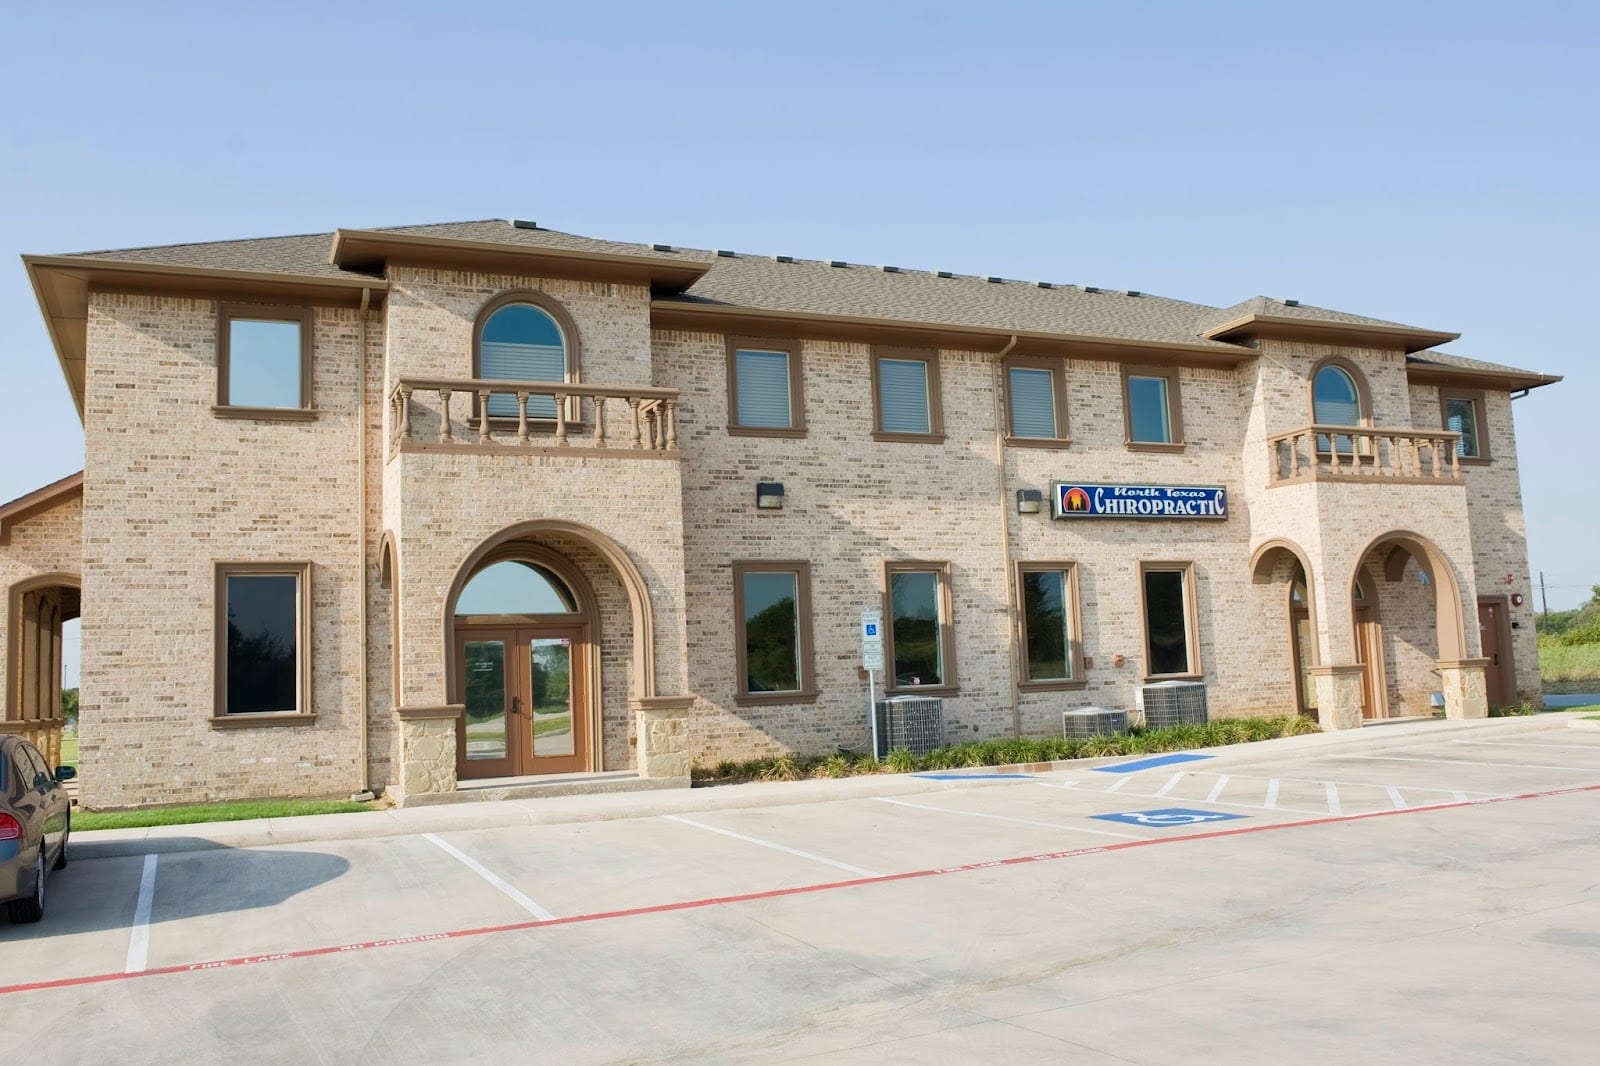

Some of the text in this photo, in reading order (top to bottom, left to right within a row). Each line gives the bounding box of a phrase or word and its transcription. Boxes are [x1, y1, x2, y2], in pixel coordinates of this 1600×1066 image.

[1114, 487, 1206, 498] North Texas
[1094, 487, 1225, 515] CHIROPRACTIC
[340, 944, 365, 952] NO
